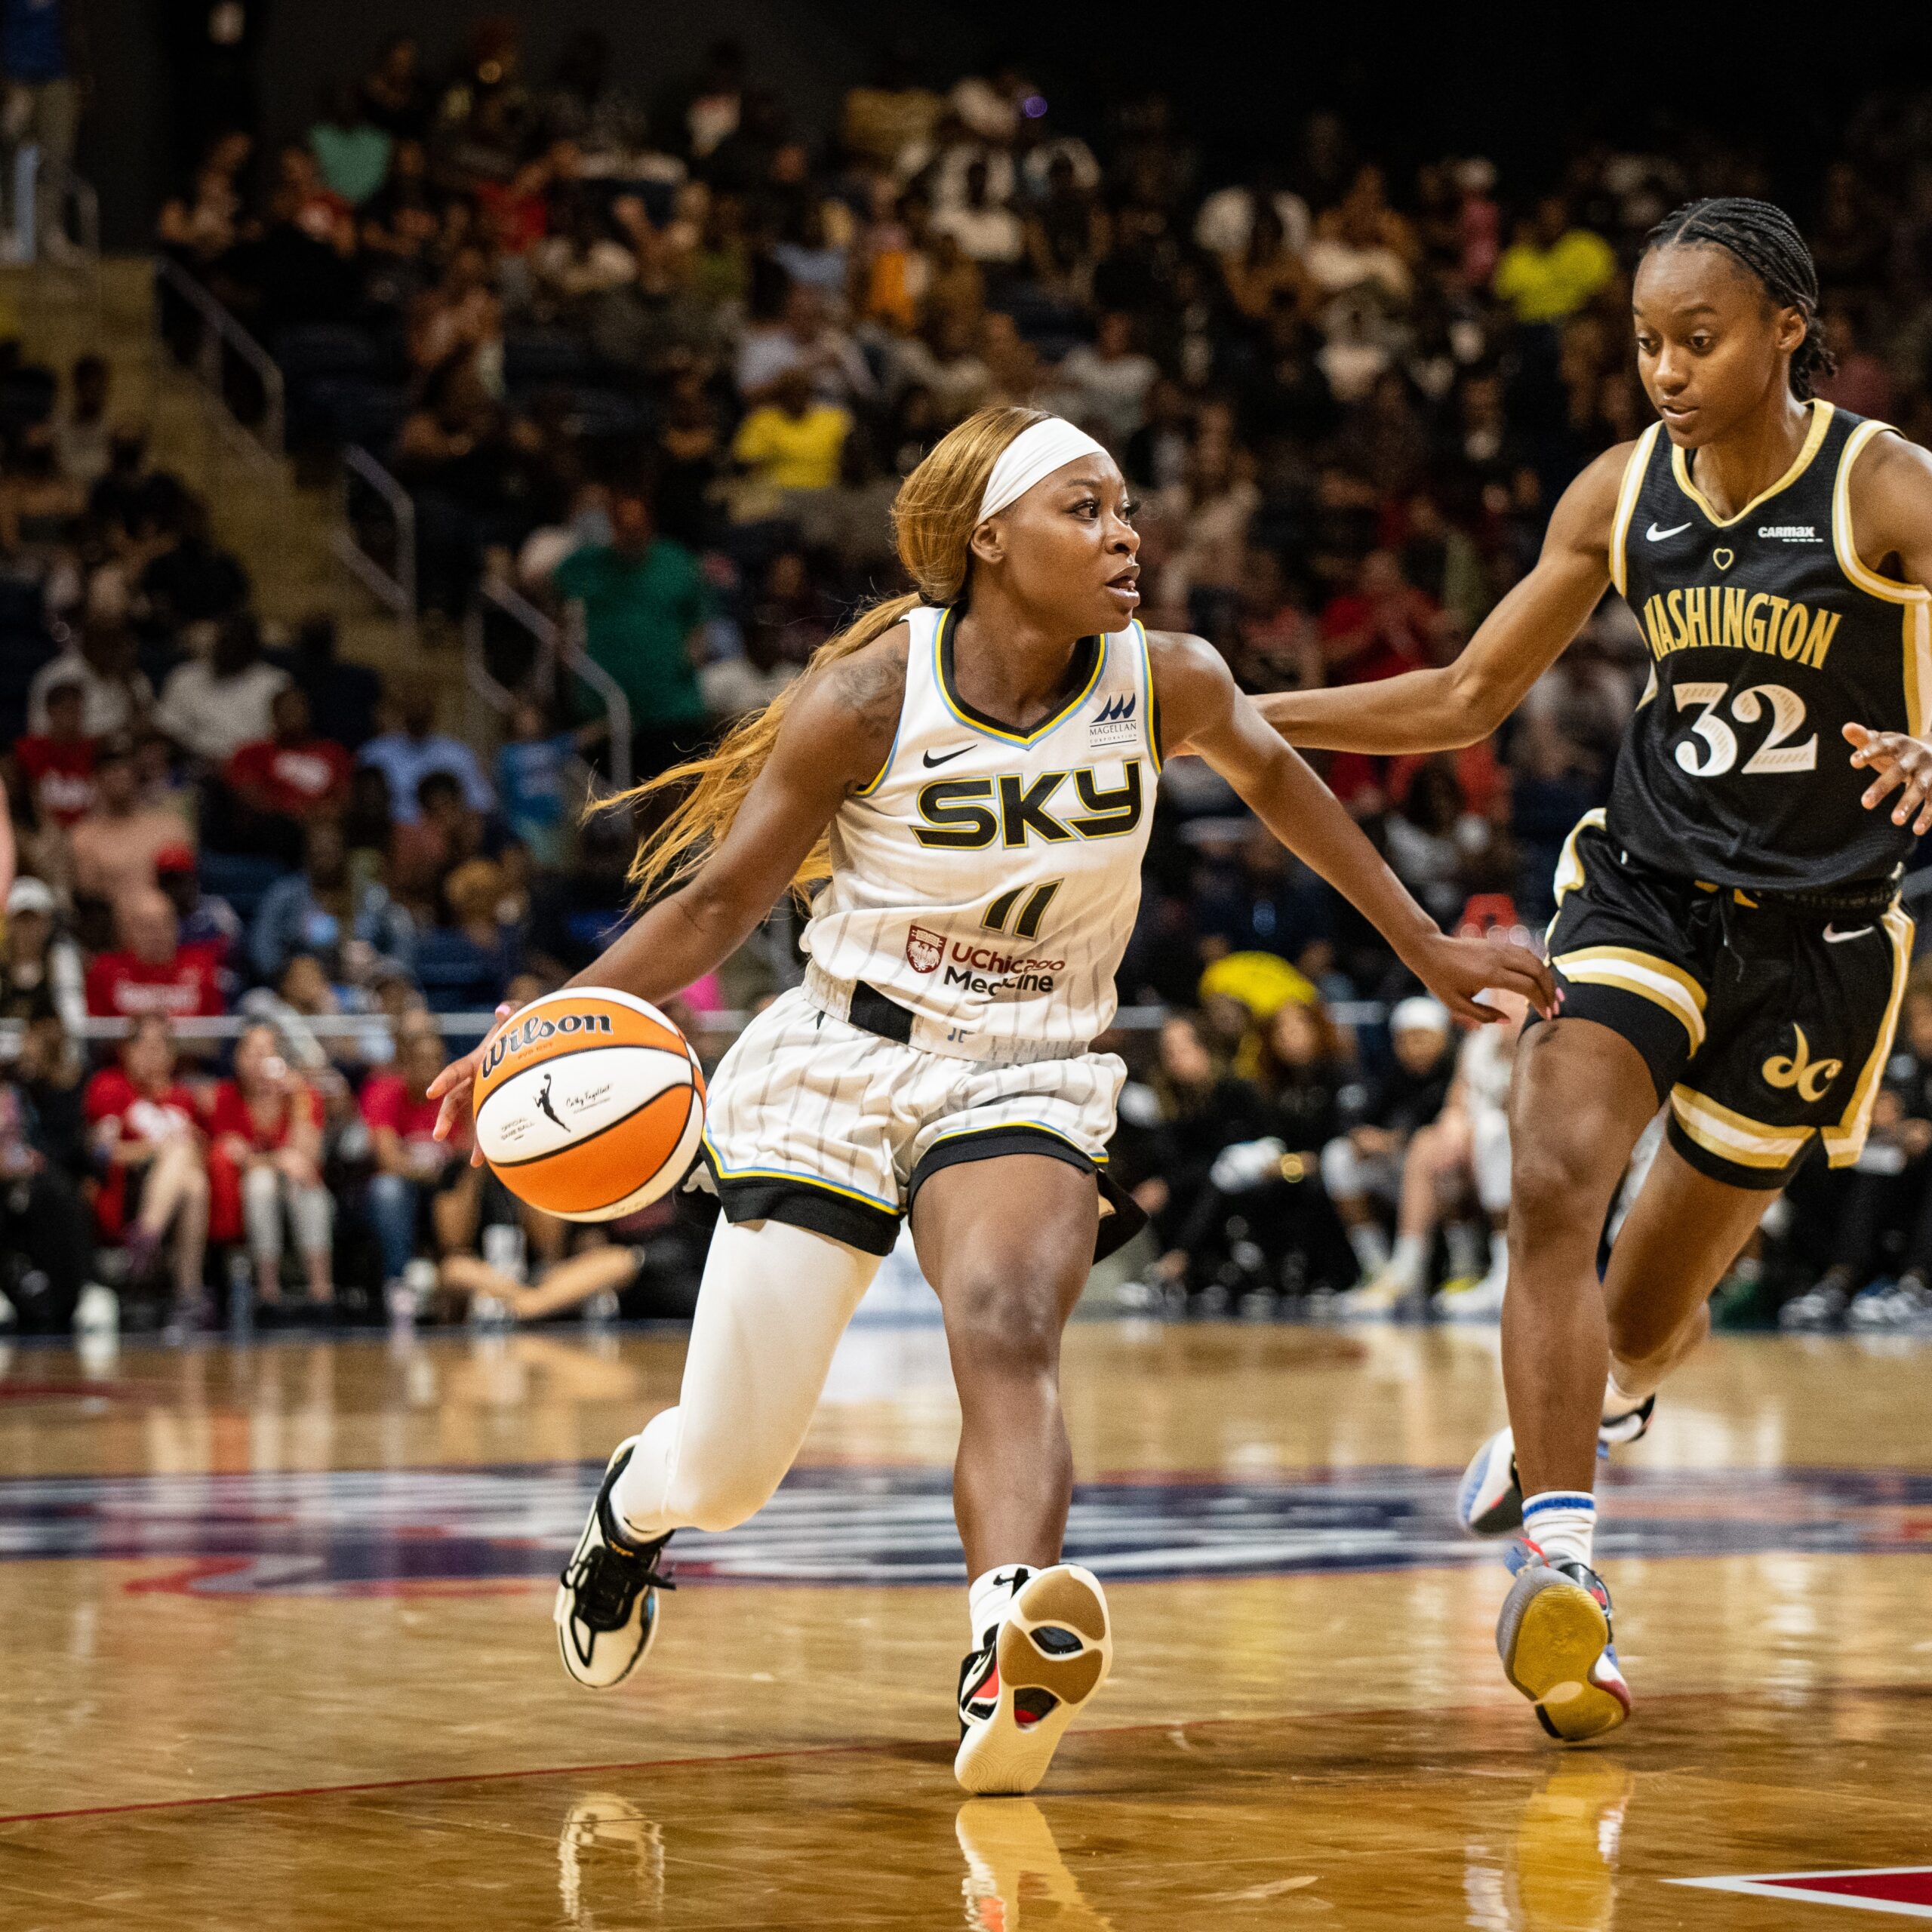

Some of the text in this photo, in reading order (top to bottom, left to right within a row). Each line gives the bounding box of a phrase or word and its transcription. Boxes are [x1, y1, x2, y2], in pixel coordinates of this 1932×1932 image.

[1089, 722, 1137, 737] MAGELLAN
[1672, 681, 1819, 777] 32
[907, 757, 1144, 852] SKY
[980, 878, 1065, 942] 11
[952, 942, 1066, 974] UChicago
[481, 1014, 614, 1079] Wilson
